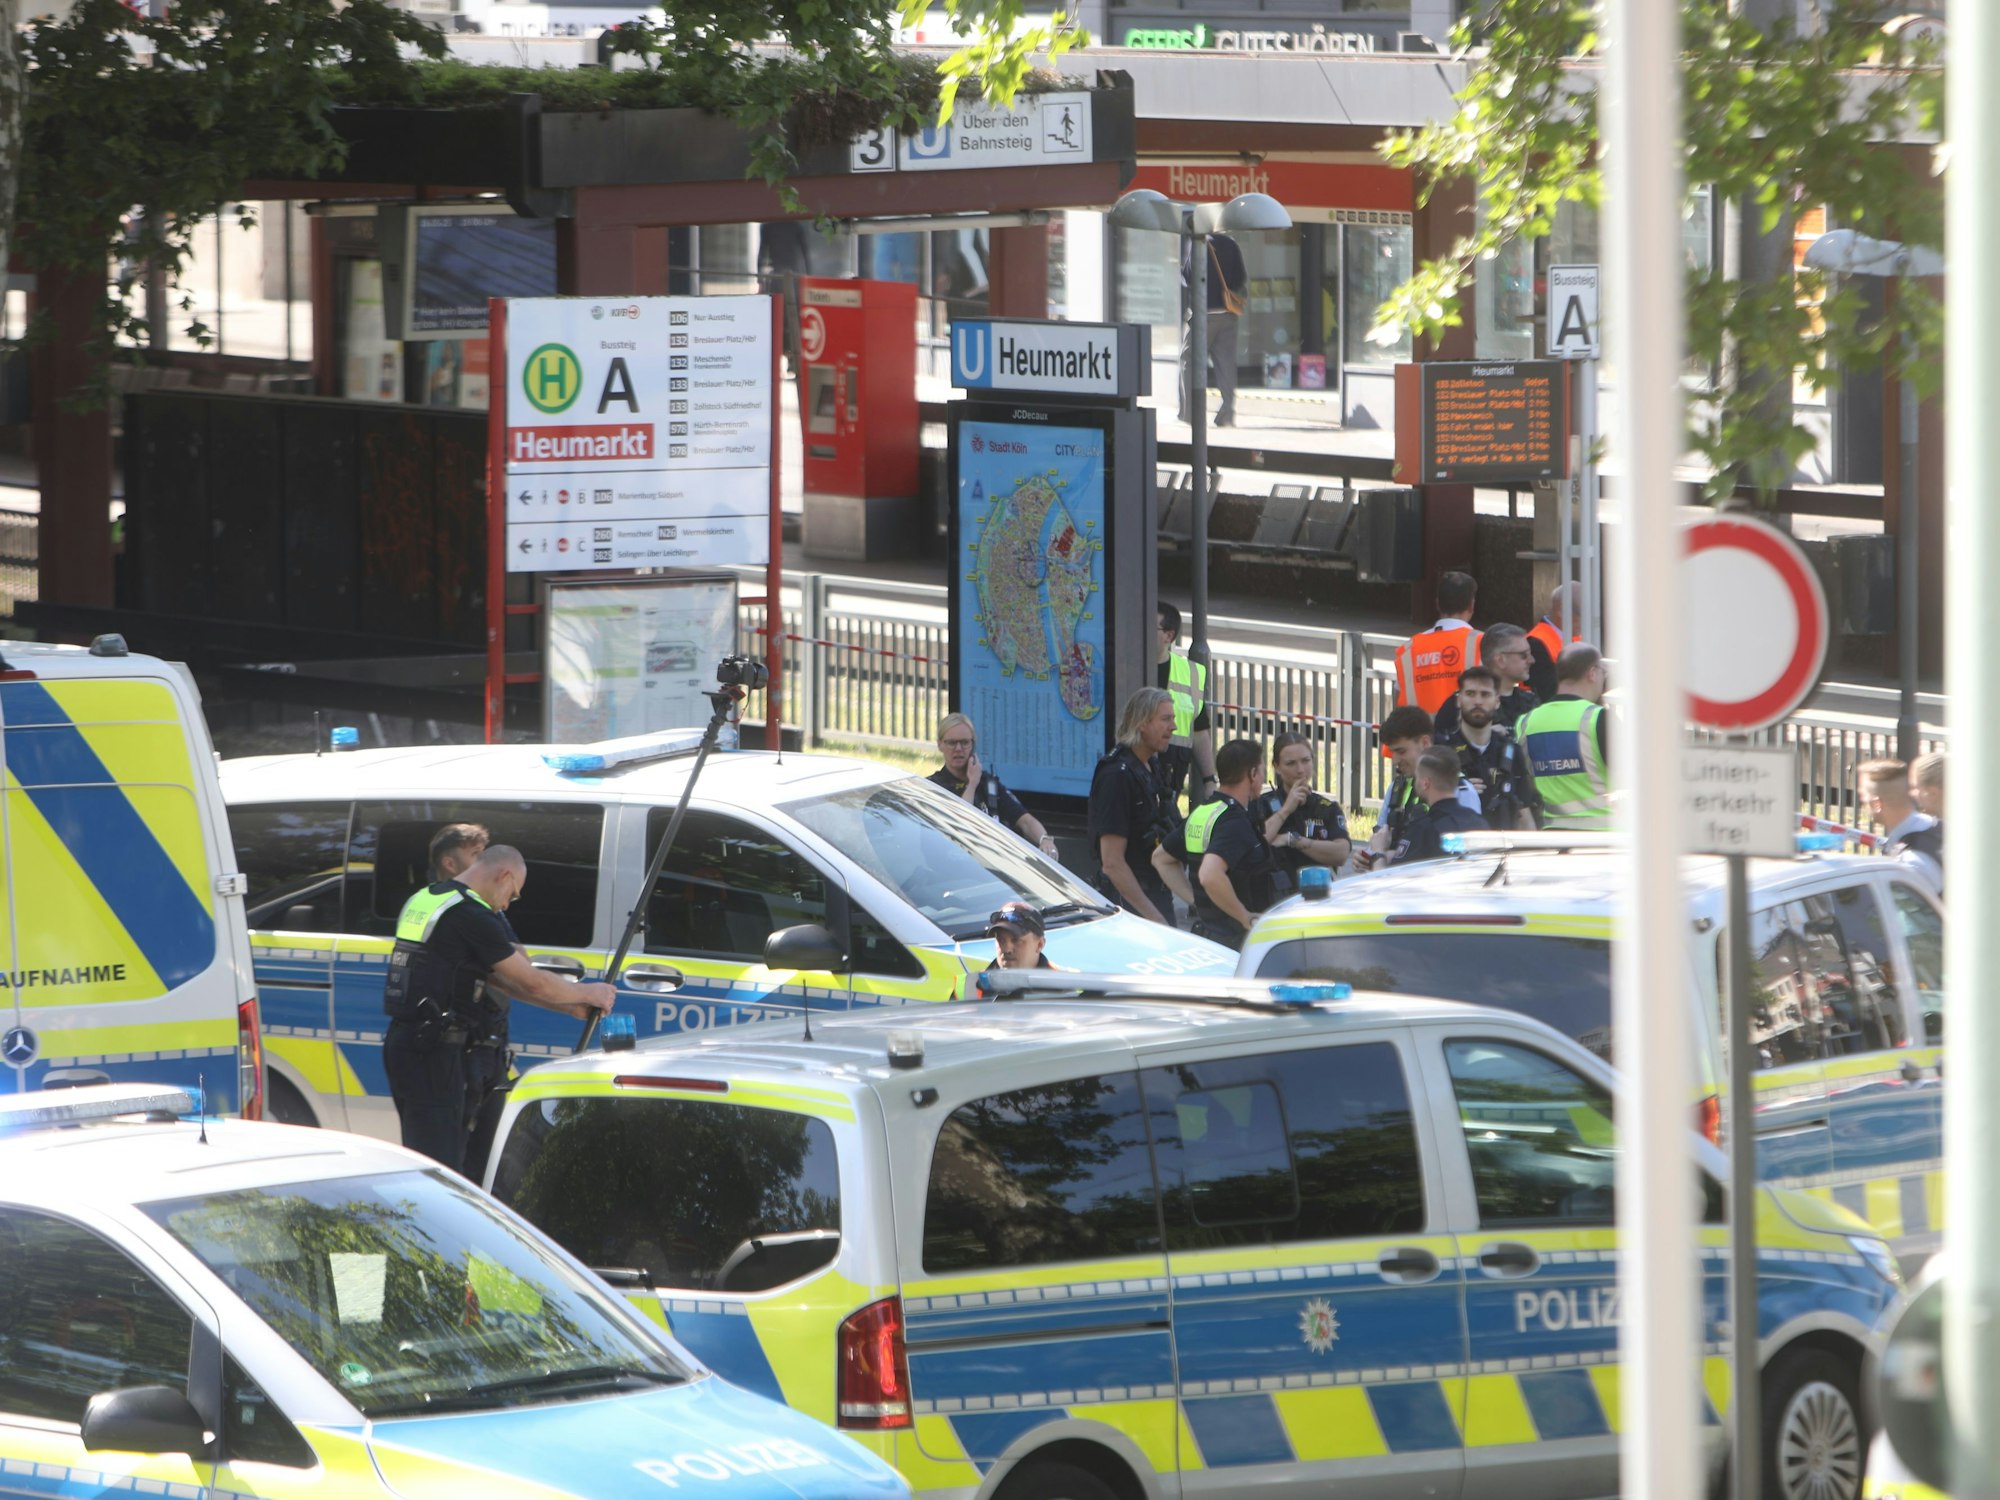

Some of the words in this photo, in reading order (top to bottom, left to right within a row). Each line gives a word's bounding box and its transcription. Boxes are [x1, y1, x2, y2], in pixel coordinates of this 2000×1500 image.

[963, 111, 997, 129] Über
[1003, 114, 1029, 127] den
[960, 134, 1032, 151] Bahnsteig
[1169, 166, 1270, 197] Heumarkt
[1554, 273, 1595, 288] Bussteig
[1556, 295, 1592, 345] A
[601, 341, 636, 350] Bussteig
[672, 335, 688, 346] 132
[726, 335, 756, 343] Platz/Hbf
[672, 357, 688, 368] 132
[959, 328, 984, 380] U
[1000, 337, 1111, 380] Heumarkt
[539, 357, 566, 400] H
[1472, 365, 1514, 376] Heumarkt
[597, 357, 640, 414] A
[672, 380, 688, 390] 133
[726, 380, 756, 388] Platz/Hbf
[672, 402, 687, 412] 133
[1012, 409, 1048, 420] JCDecaux
[515, 428, 647, 458] Heumarkt
[989, 441, 1010, 452] Stadt
[1012, 442, 1027, 454] Köln
[578, 493, 586, 504] B
[578, 541, 586, 552] C
[595, 531, 611, 540] 260
[659, 528, 676, 538] N26
[683, 528, 734, 536] Wermelskirchen
[1416, 652, 1441, 668] KVB
[1708, 820, 1750, 843] frei
[632, 1438, 830, 1488] POLIZEI
